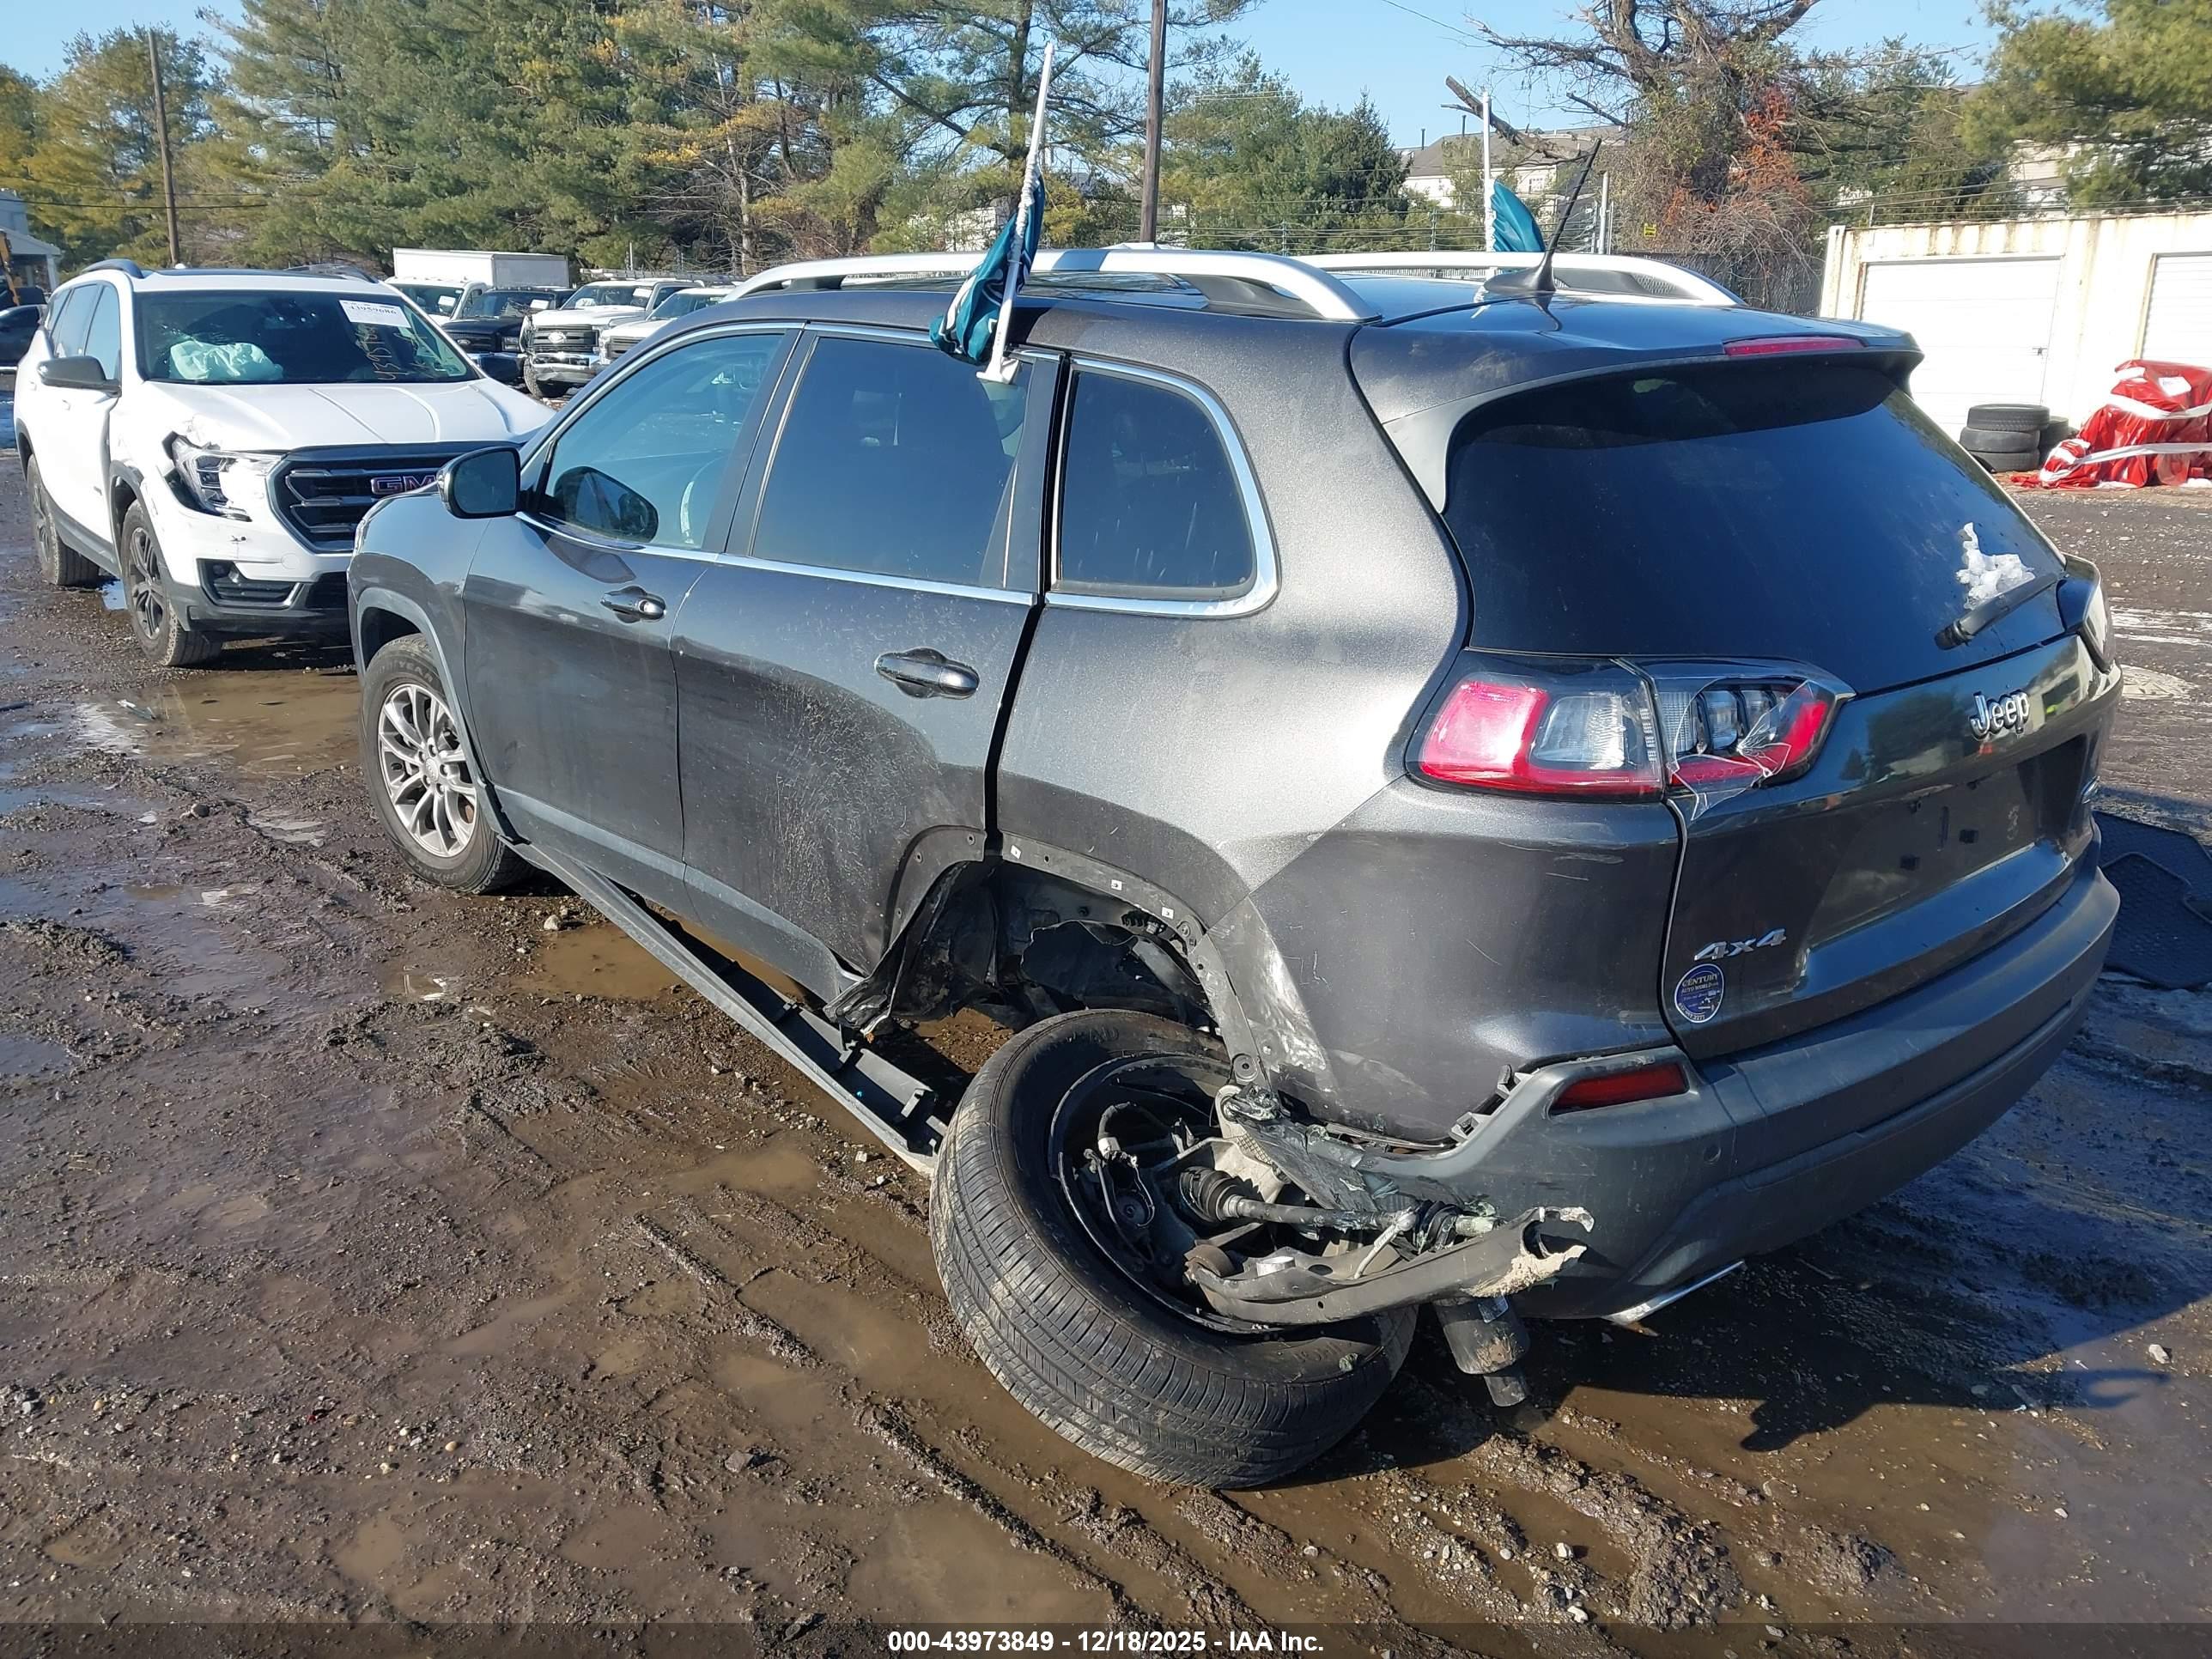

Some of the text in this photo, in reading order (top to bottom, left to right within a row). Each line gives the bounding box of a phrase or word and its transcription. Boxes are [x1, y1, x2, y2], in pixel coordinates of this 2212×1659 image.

[371, 475, 438, 495] GM
[1970, 690, 2030, 737] Jeep
[1694, 928, 1787, 961] 4x4
